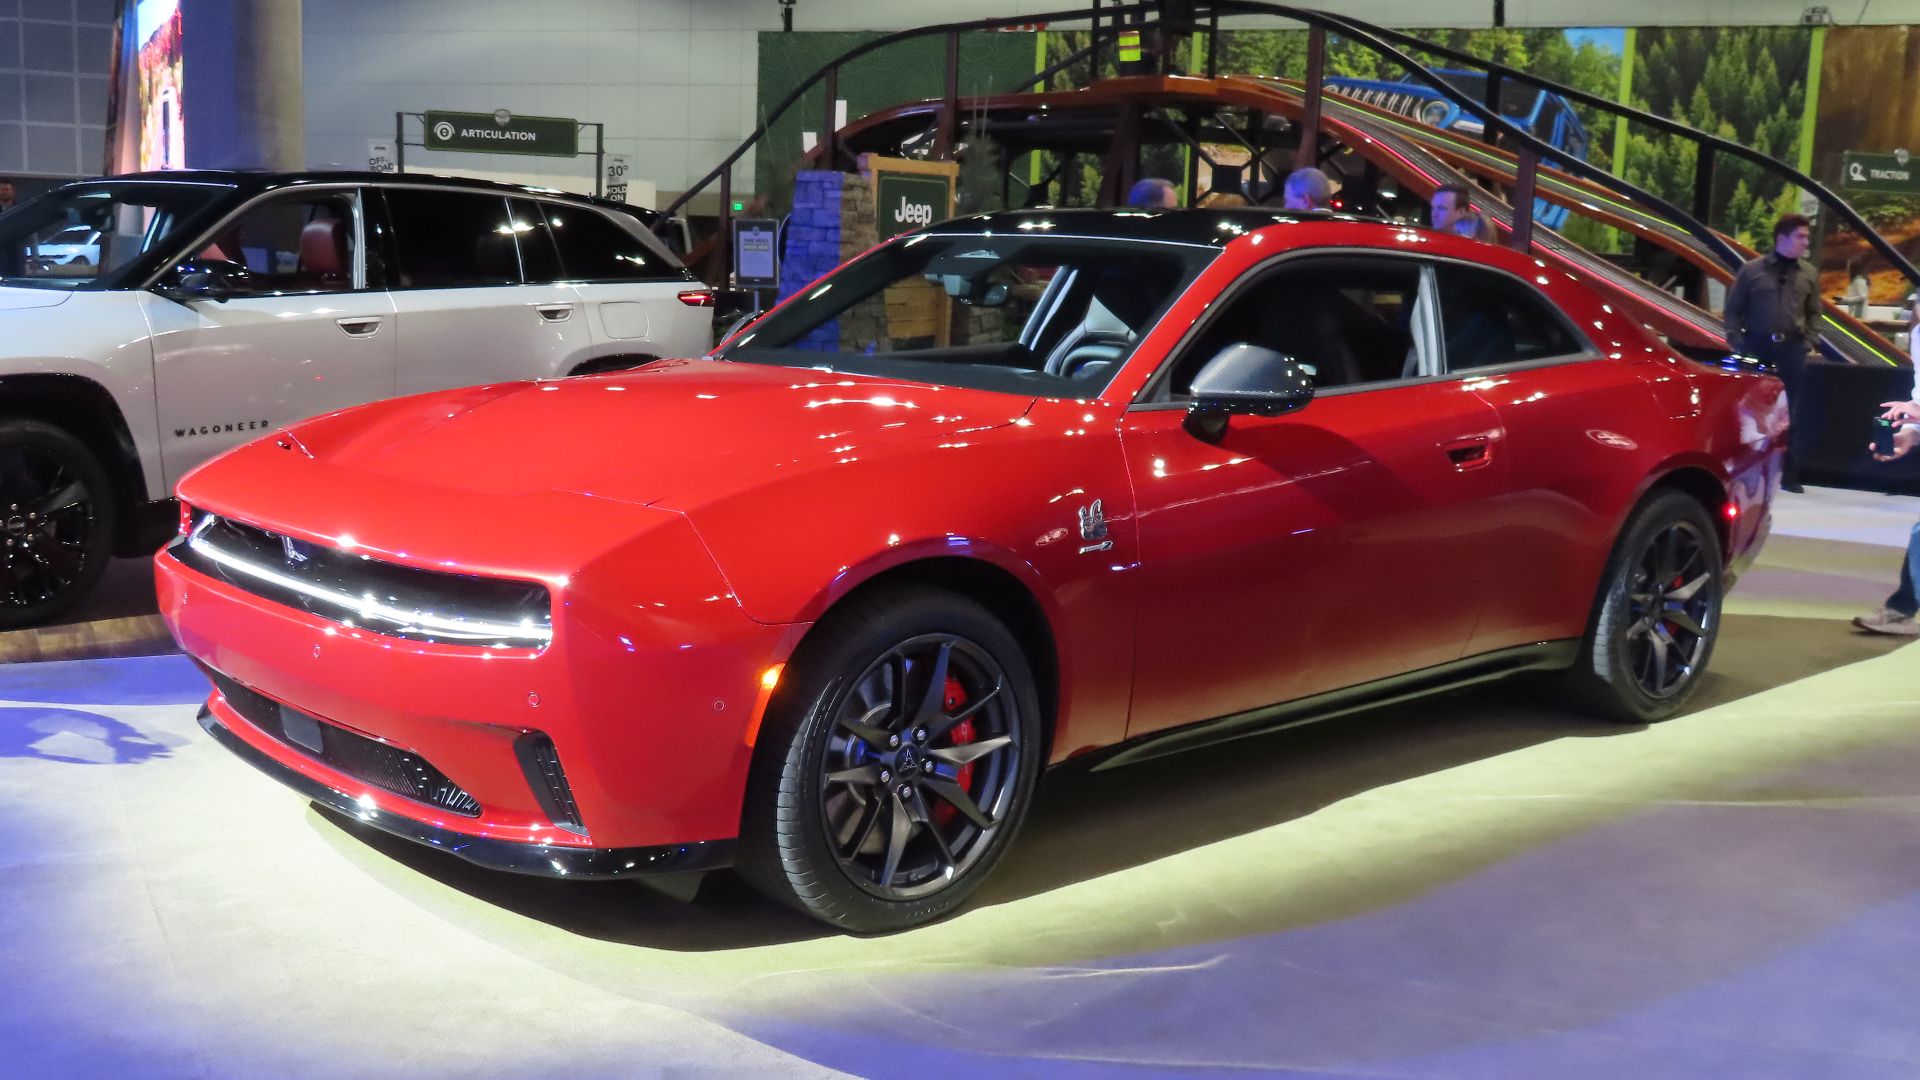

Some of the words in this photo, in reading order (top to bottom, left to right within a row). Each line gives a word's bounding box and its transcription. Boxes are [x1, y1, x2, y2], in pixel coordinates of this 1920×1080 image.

[460, 128, 537, 142] ARTICULATION
[1869, 168, 1910, 181] TRACTION
[610, 194, 624, 202] ON
[894, 196, 932, 227] Jeep
[174, 420, 269, 438] WAGONEER
